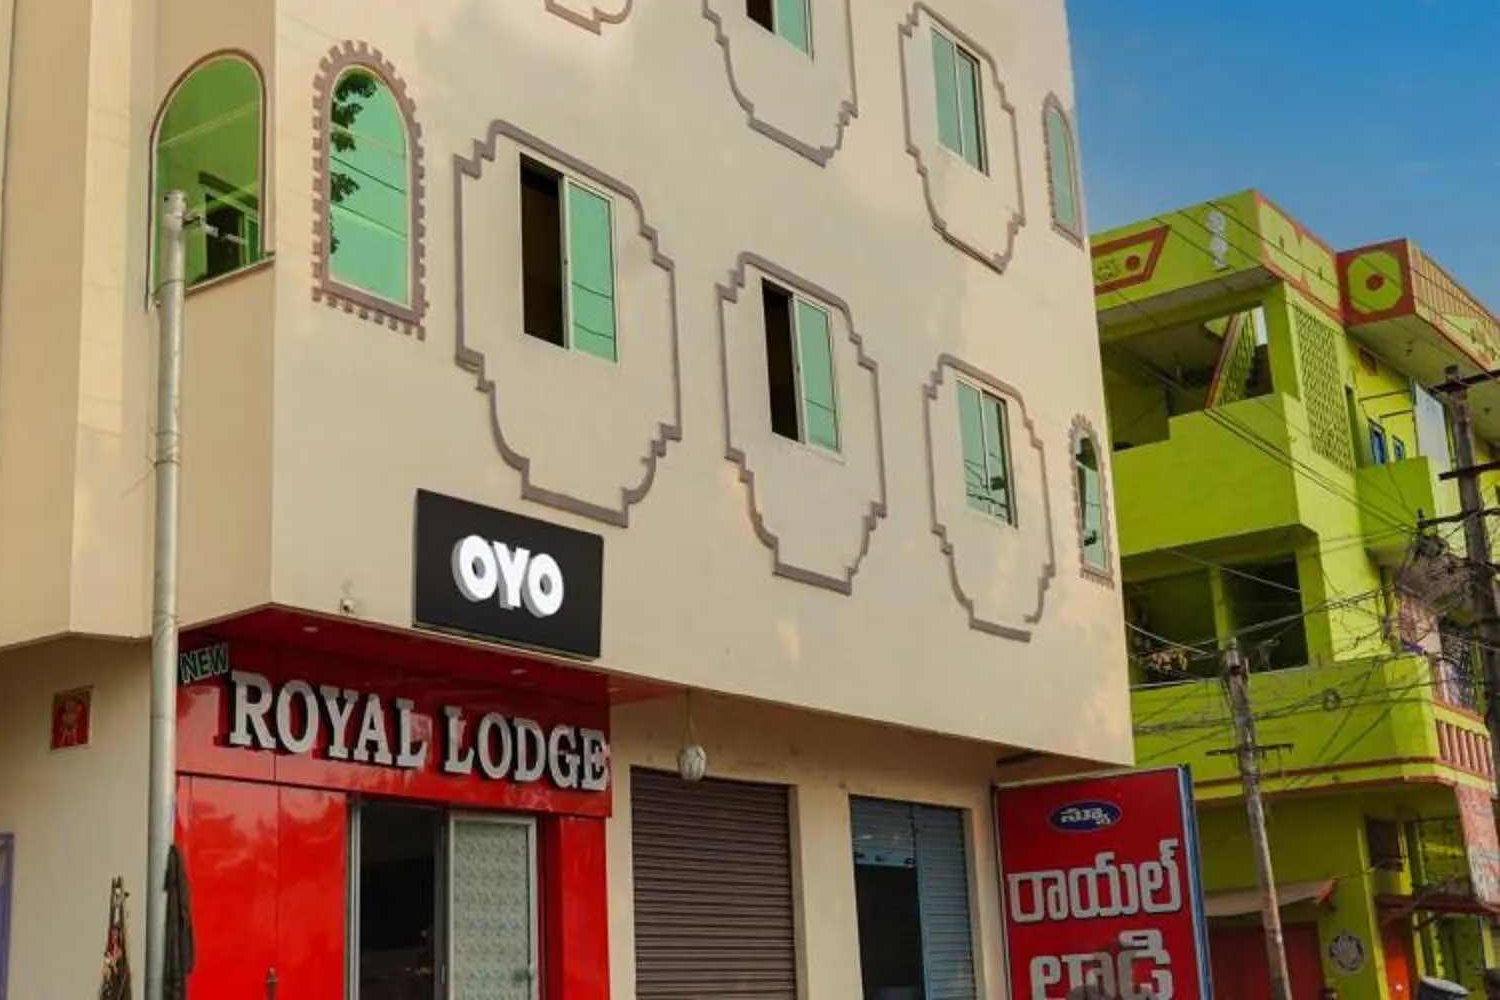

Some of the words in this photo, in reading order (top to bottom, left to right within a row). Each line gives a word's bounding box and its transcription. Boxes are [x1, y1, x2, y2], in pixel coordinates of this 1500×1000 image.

[451, 534, 565, 618] OYO
[178, 643, 229, 684] NEW
[229, 670, 428, 769] ROYAL
[443, 705, 610, 792] LODGE
[1007, 838, 1182, 923] రాయల్
